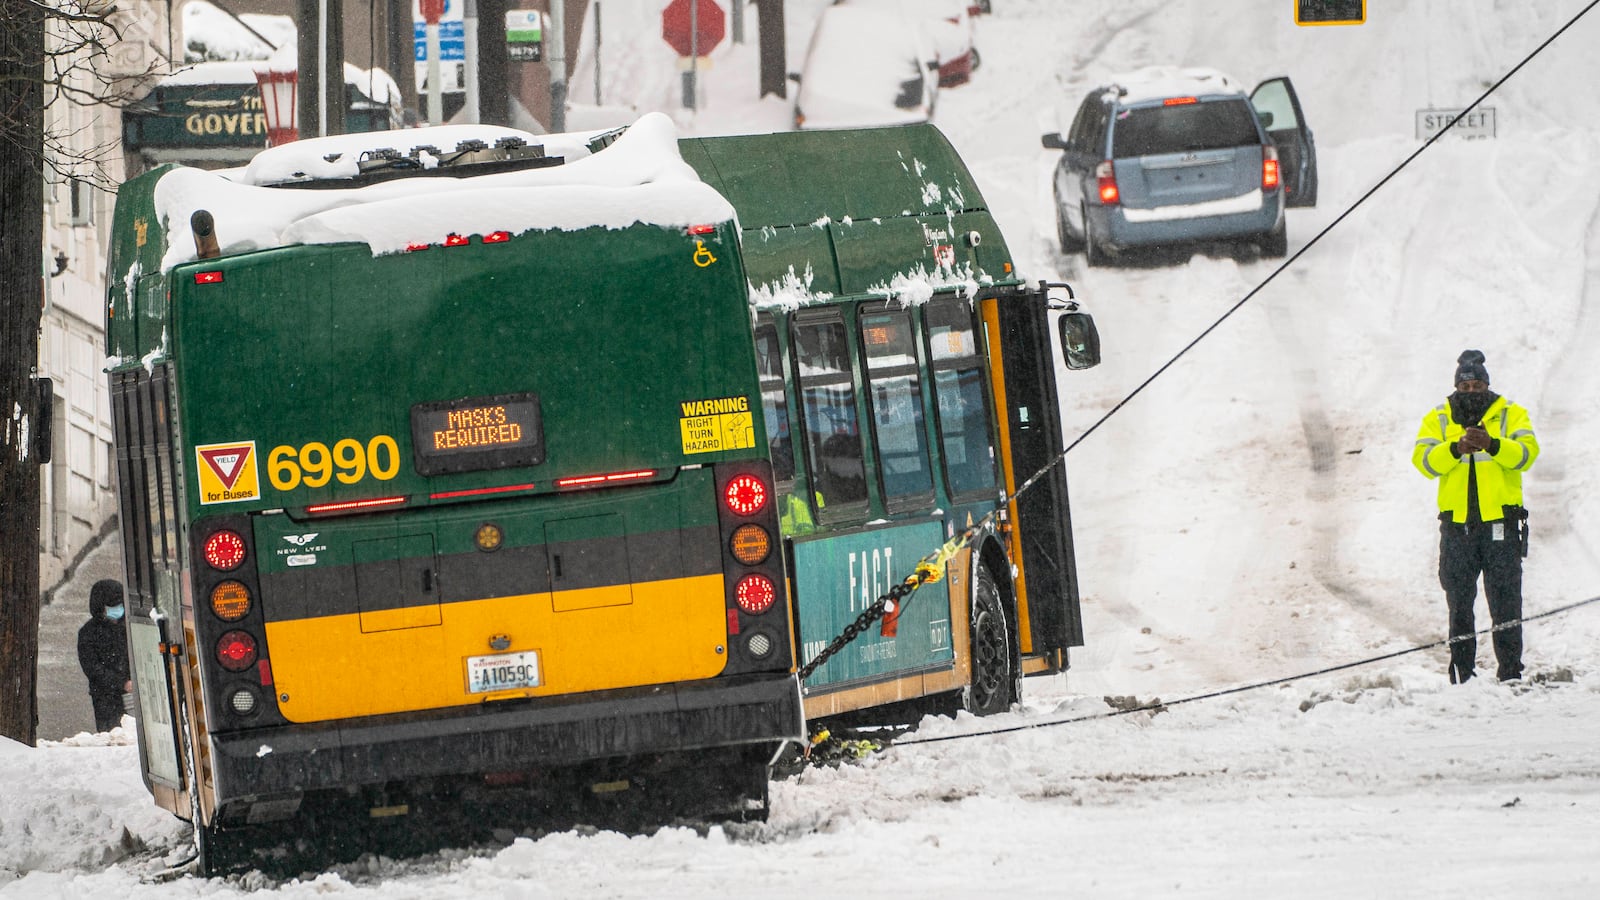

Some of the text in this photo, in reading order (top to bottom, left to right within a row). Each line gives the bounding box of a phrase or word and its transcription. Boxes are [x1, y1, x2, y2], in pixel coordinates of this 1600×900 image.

[241, 95, 263, 110] TH
[1425, 113, 1486, 129] STREET
[681, 396, 748, 417] WARNING
[448, 406, 506, 429] MASKS
[686, 417, 713, 429] RIGHT
[433, 423, 521, 449] REQUIRED
[689, 429, 713, 439] TURN
[685, 439, 720, 451] HAZARD
[216, 456, 236, 464] YIELD
[267, 435, 400, 491] 6990
[207, 490, 253, 501] for Buses
[848, 547, 893, 613] FACT
[482, 664, 534, 686] A1059C
